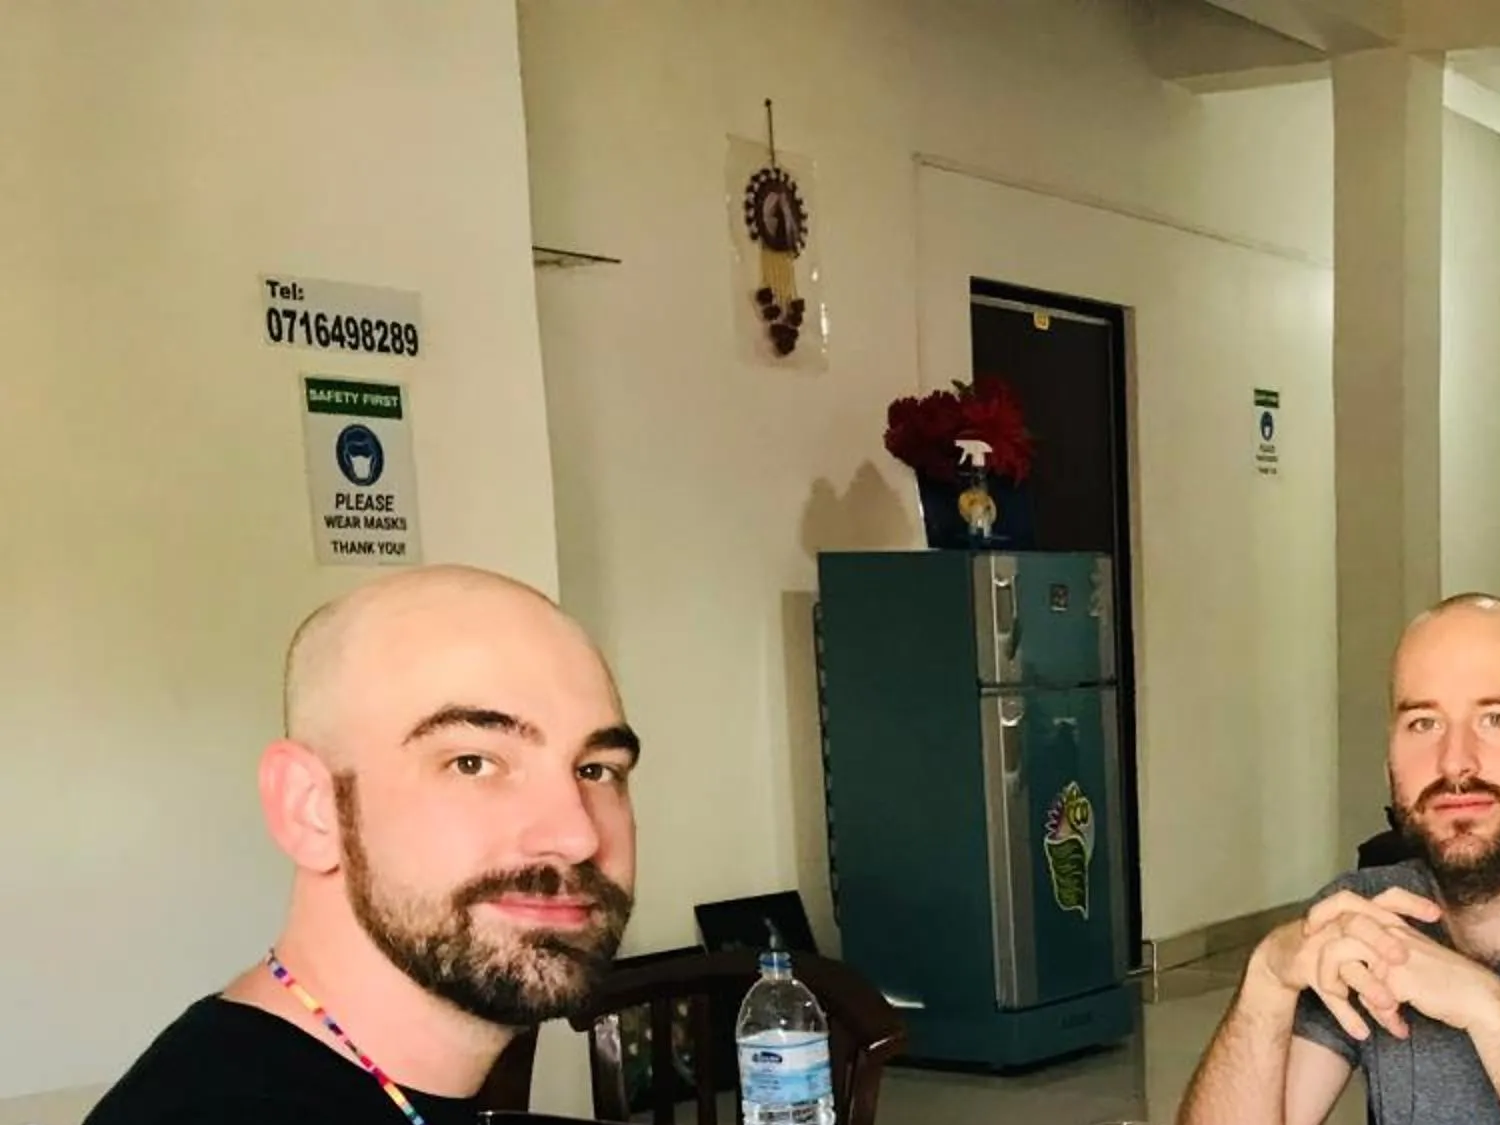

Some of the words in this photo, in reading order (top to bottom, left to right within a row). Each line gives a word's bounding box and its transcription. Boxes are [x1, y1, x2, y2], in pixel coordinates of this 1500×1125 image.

[266, 280, 304, 300] Tel:
[267, 307, 419, 357] 0716498289
[310, 388, 358, 404] SAFETY
[363, 393, 398, 407] FIRST
[335, 492, 394, 512] PLEASE
[323, 515, 360, 529] WEAR
[331, 540, 375, 555] THANK
